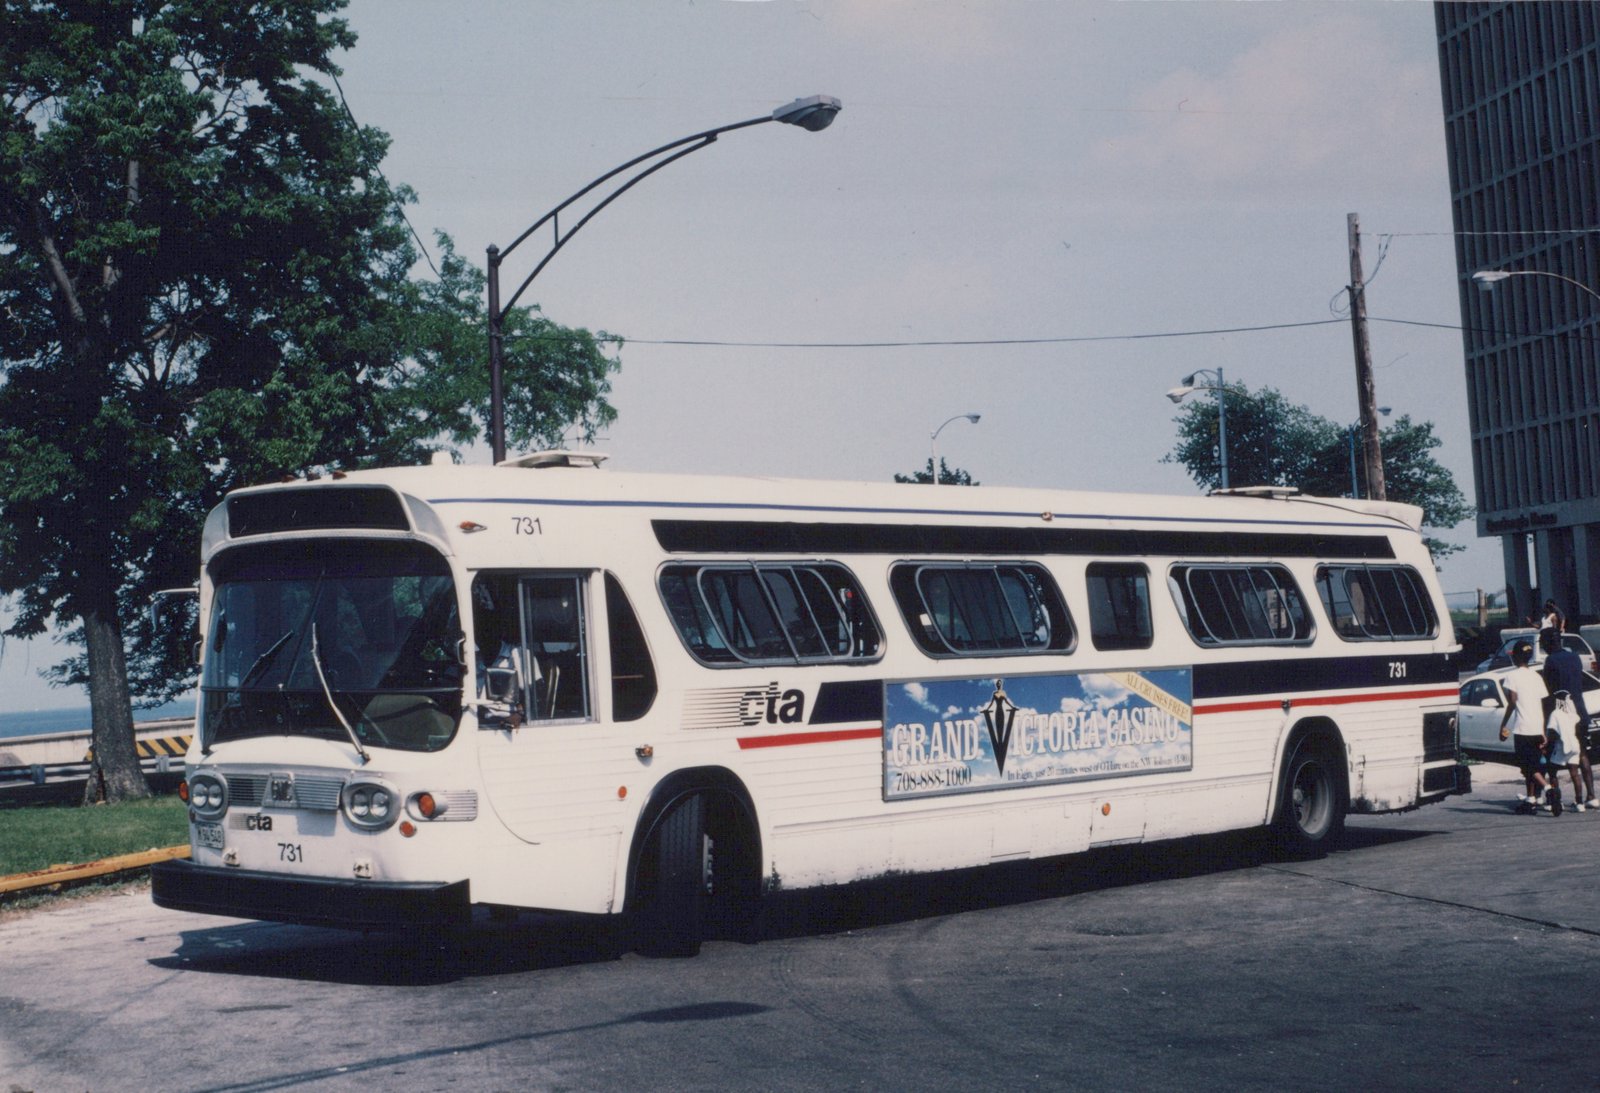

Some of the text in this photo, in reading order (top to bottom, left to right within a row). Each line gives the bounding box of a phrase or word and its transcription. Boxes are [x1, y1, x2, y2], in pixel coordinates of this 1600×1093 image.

[511, 516, 542, 535] 731
[1388, 661, 1406, 678] 731
[739, 682, 805, 726] cta
[892, 706, 1178, 778] GRAND VICTORIA CASINO
[896, 766, 972, 791] 708-888-1000
[246, 812, 273, 831] cta
[277, 843, 302, 863] 731
